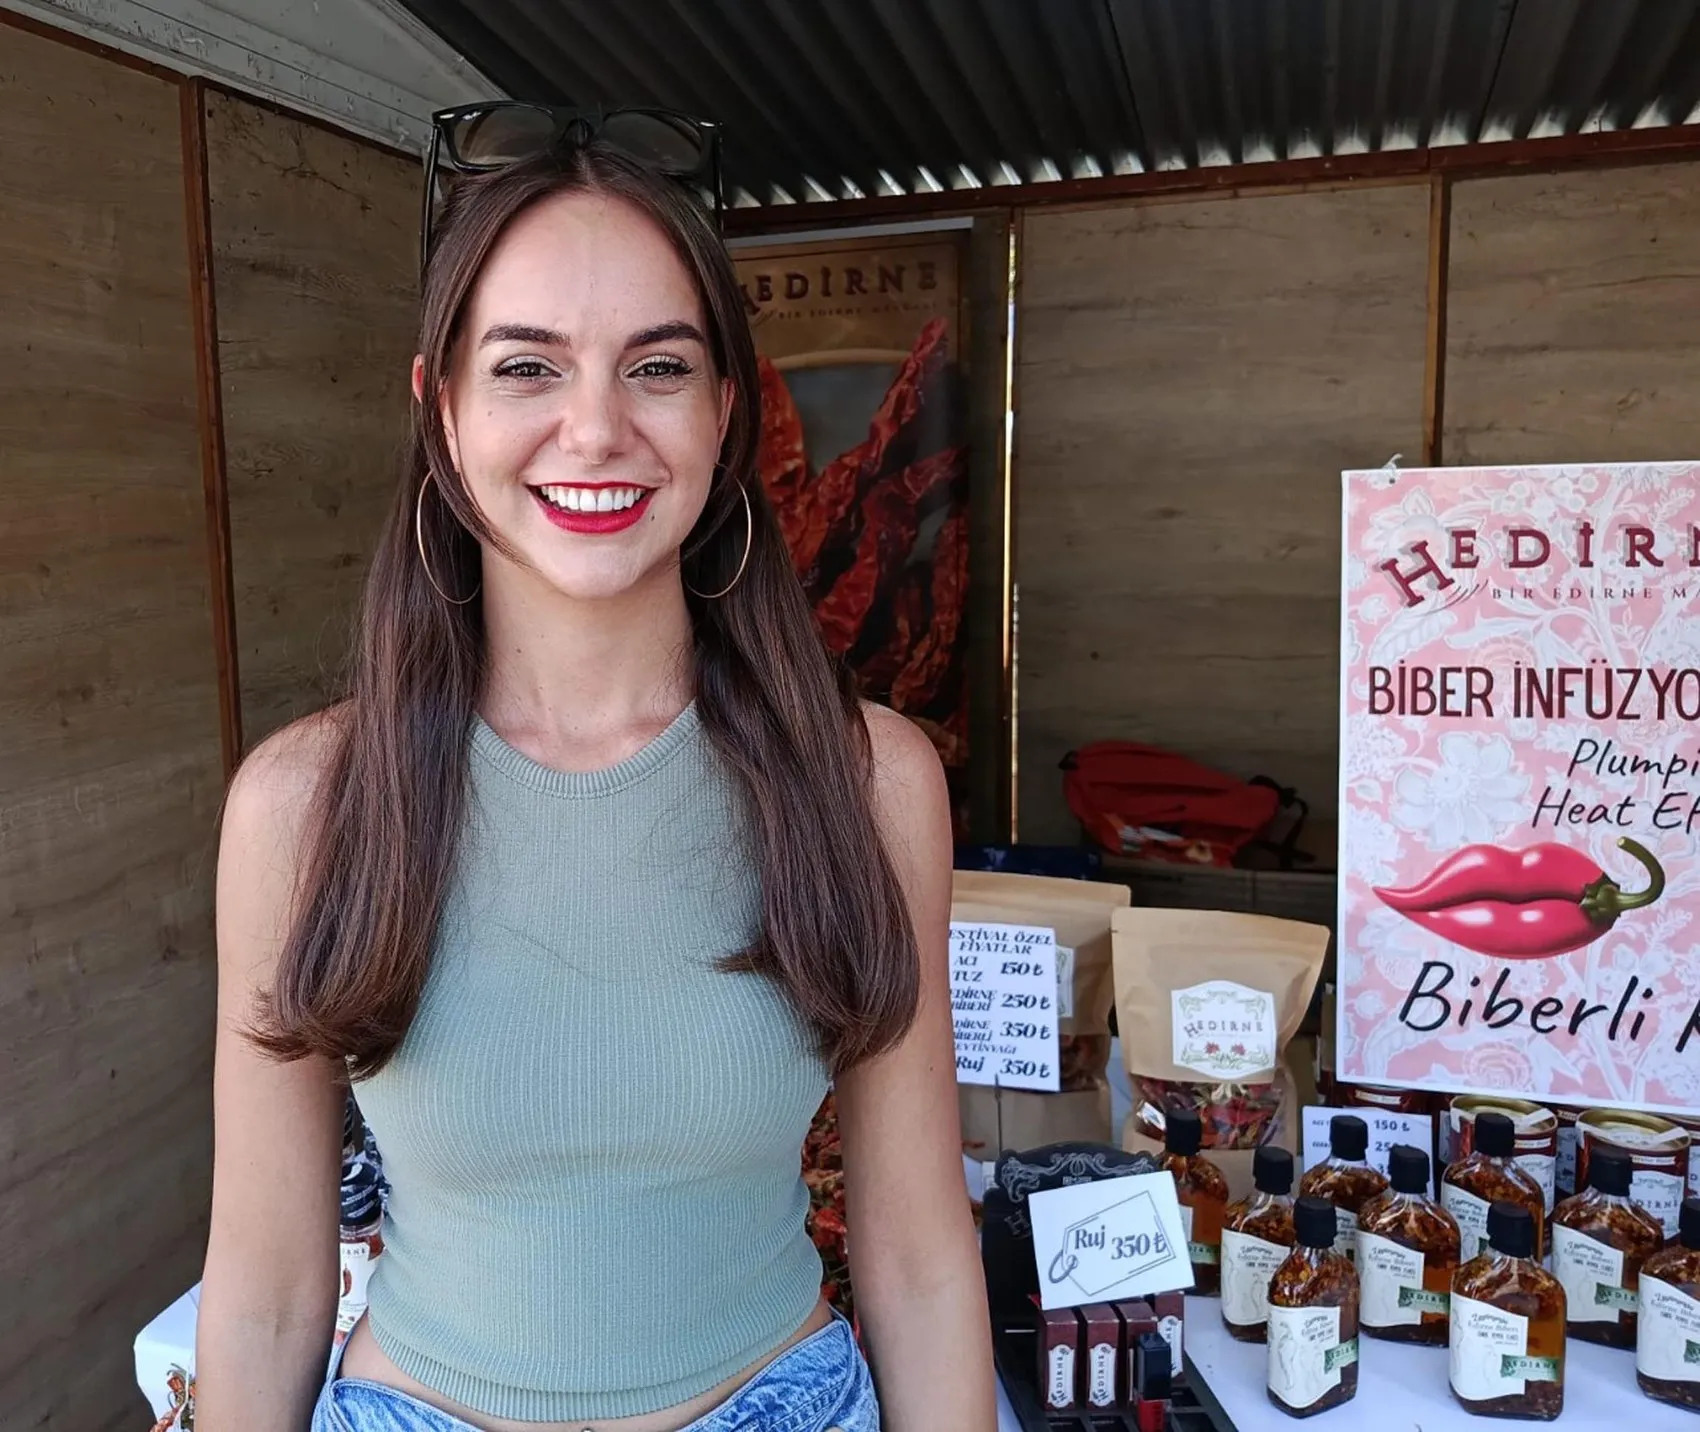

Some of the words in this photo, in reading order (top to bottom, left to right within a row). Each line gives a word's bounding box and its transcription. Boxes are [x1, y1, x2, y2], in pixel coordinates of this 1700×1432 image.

[1381, 521, 1700, 608] HEDİR
[1492, 587, 1534, 600] BİR
[1552, 586, 1653, 600] EDİRNE
[1368, 659, 1494, 719] BİBER
[1532, 786, 1635, 828] Heat
[949, 927, 1010, 942] ESTİVAL
[1014, 931, 1052, 945] ÖZEL
[959, 939, 1032, 955] FİYATLAR
[954, 955, 978, 966] ACI
[1000, 961, 1030, 976] 150
[953, 970, 984, 982] TUZ
[949, 986, 998, 1001] DİRNE
[1001, 993, 1037, 1009] 250
[1398, 961, 1653, 1040] Biberli
[954, 1018, 992, 1029] DİRNE
[1000, 1021, 1037, 1038] 350
[956, 1042, 1017, 1055] EYTİNYAĞI
[956, 1056, 985, 1072] Ruj
[1000, 1058, 1036, 1076] 350
[1374, 1120, 1398, 1131] 150
[1074, 1224, 1106, 1250] Ruj
[1111, 1233, 1150, 1260] 350
